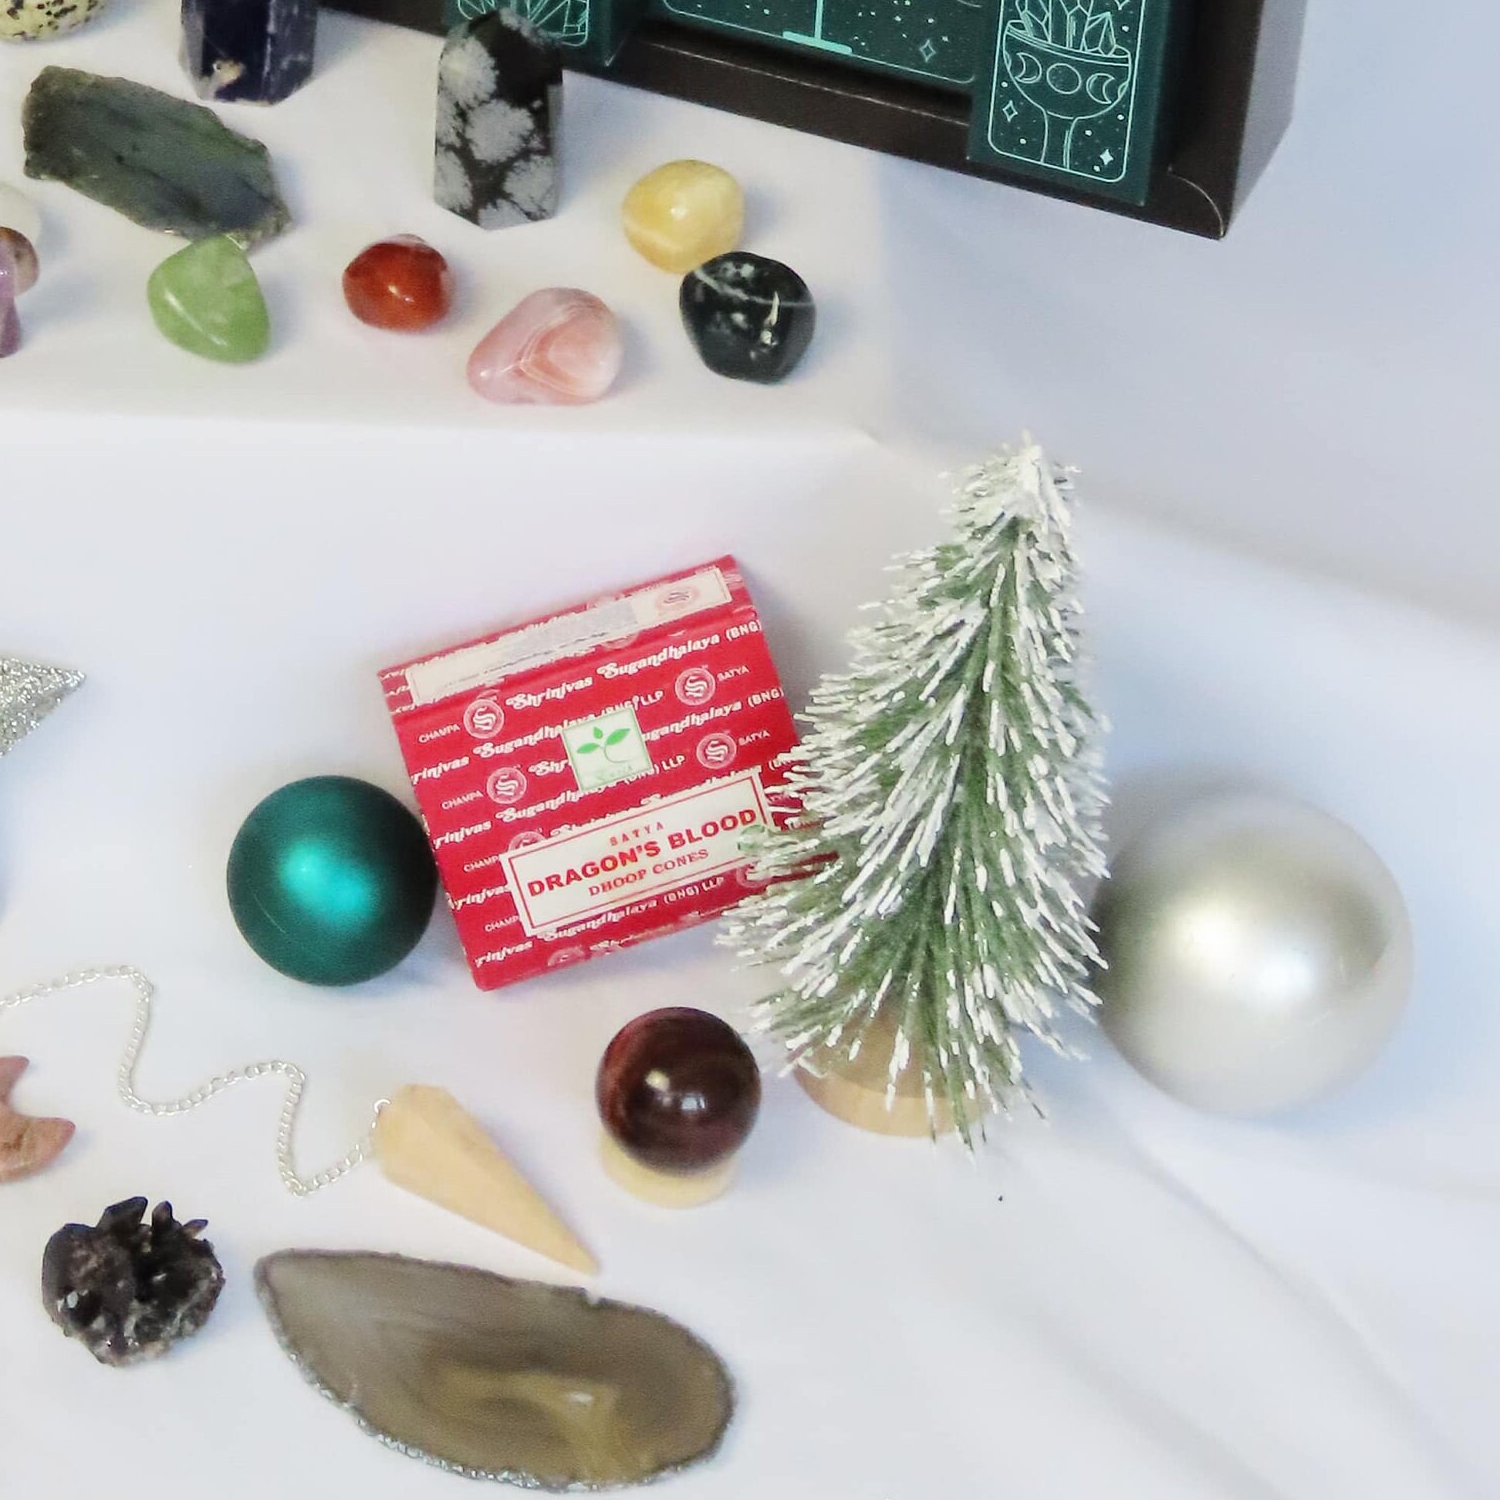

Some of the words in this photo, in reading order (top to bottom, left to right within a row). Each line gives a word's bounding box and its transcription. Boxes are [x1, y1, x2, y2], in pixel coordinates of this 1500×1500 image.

[717, 665, 749, 681] SATYA
[640, 691, 663, 705] LLP
[419, 724, 460, 742] CHAMPA
[739, 730, 770, 745] SATYA
[662, 755, 685, 770] LLP
[442, 790, 483, 809] CHAMPA
[611, 822, 665, 845] SATYA
[528, 841, 660, 896] DRAGON'S
[668, 809, 756, 849] BLOOD
[589, 869, 646, 896] DHOOP
[653, 850, 708, 874] CONES
